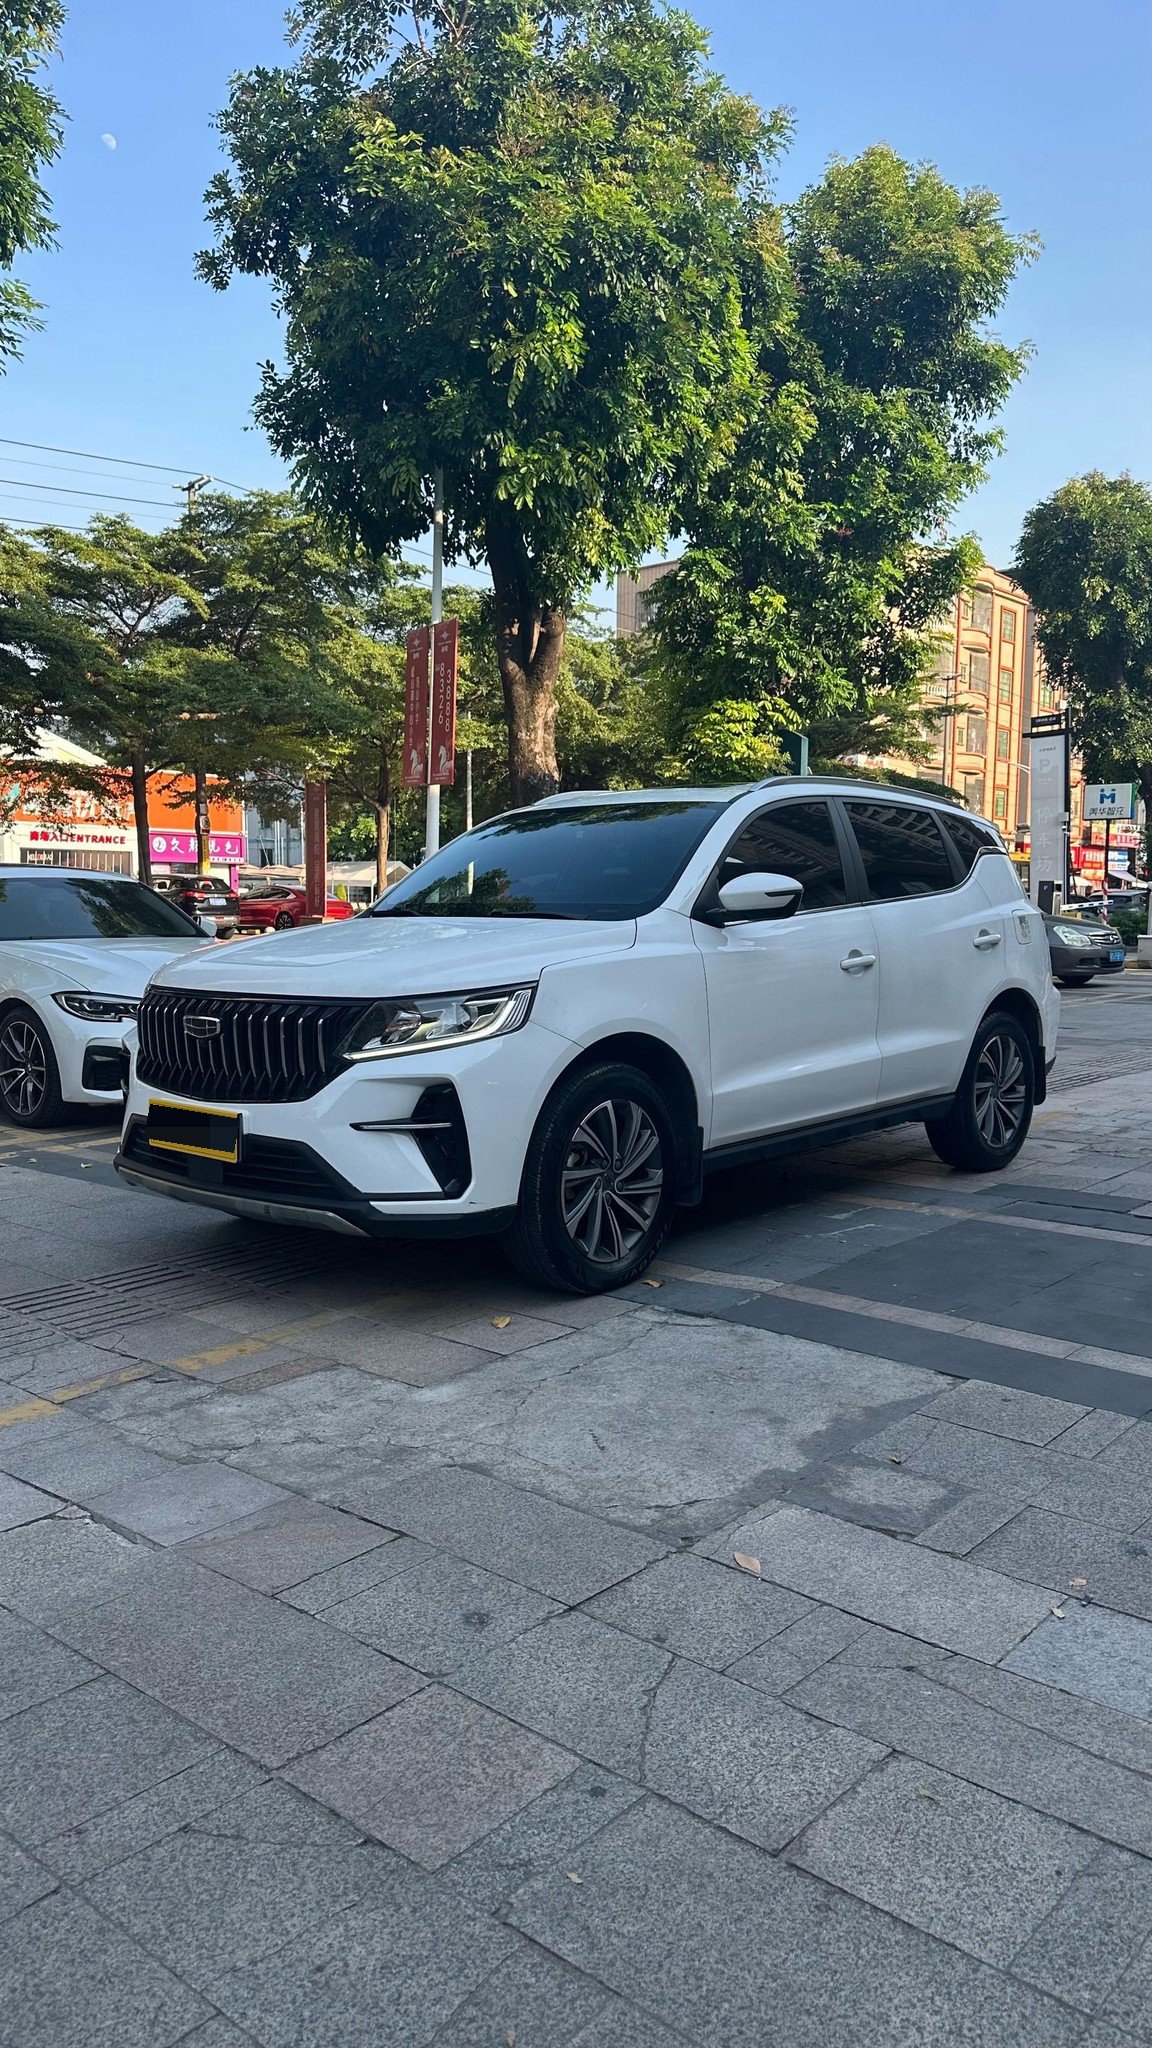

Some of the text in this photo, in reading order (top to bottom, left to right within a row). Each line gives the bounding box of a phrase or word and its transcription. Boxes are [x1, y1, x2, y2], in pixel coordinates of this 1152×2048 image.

[70, 833, 126, 844] ENTRANCE
[1036, 806, 1052, 873] 停车场
